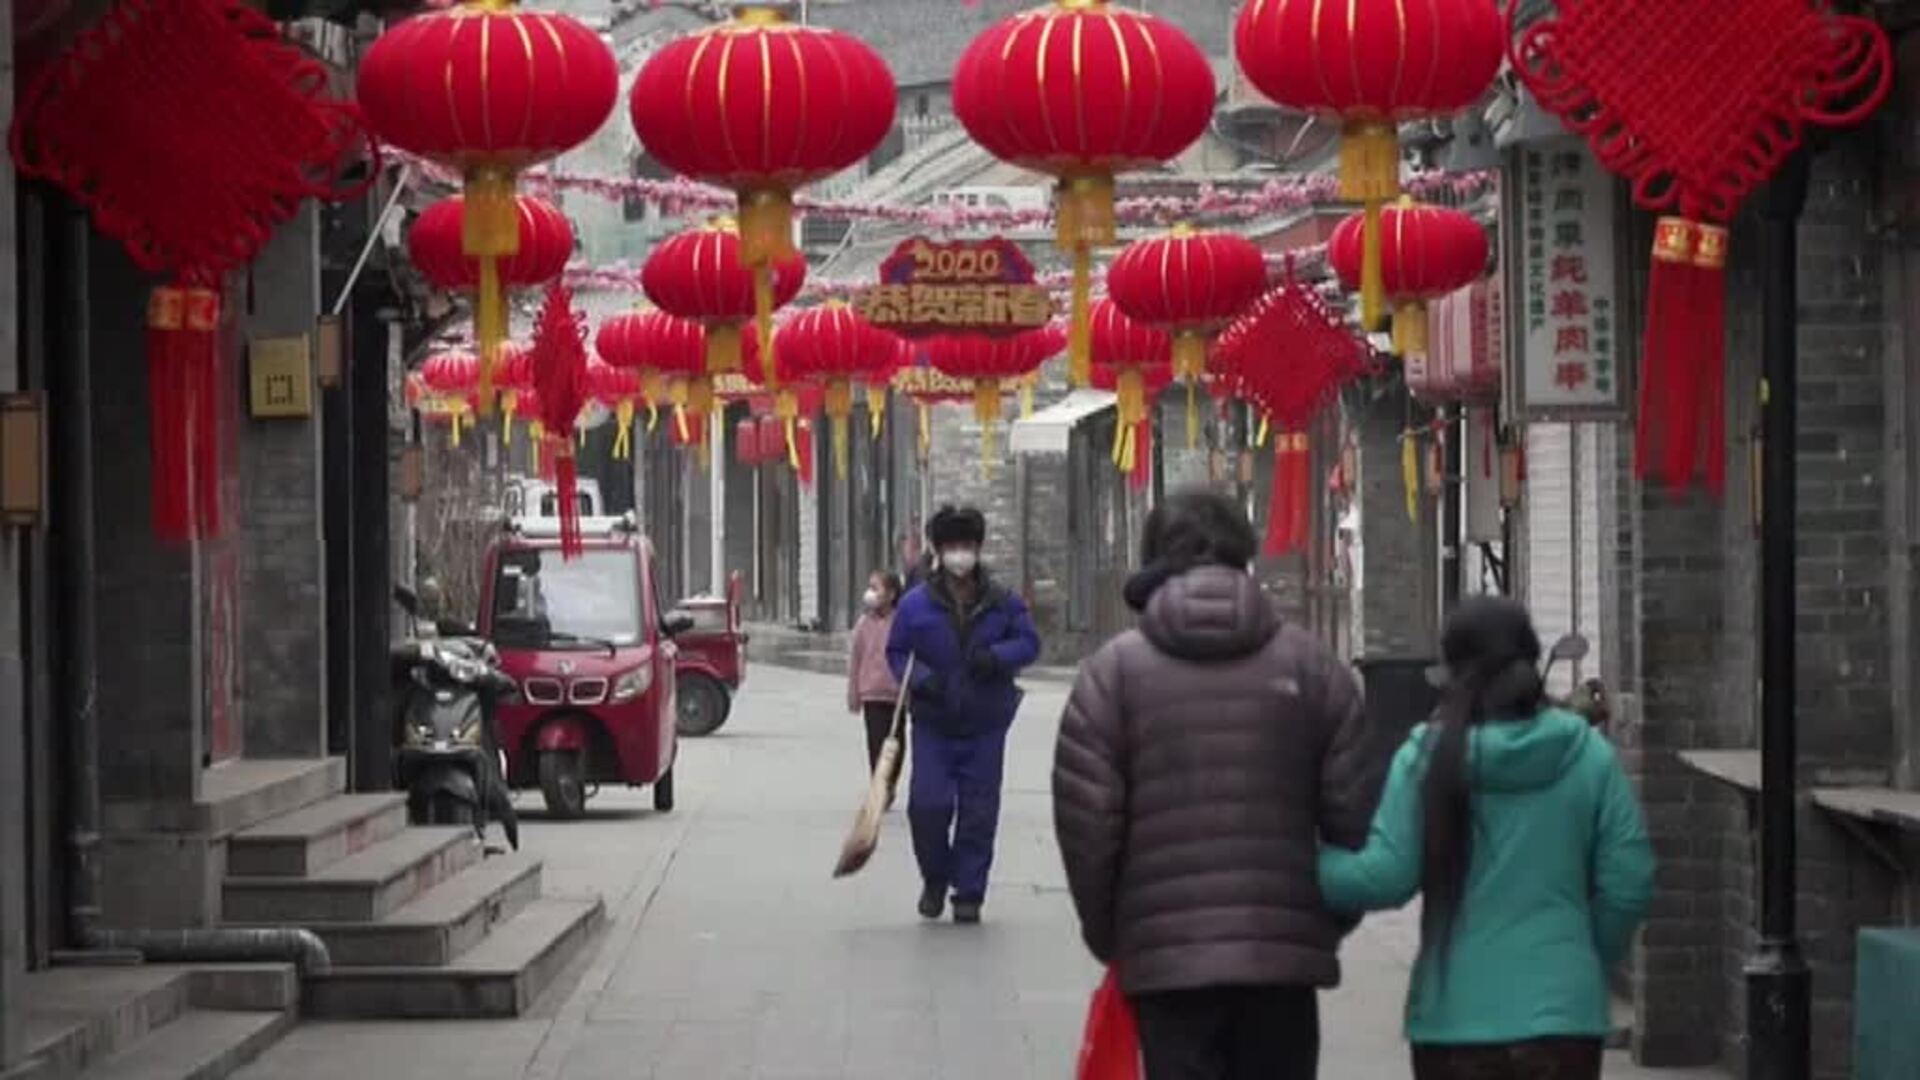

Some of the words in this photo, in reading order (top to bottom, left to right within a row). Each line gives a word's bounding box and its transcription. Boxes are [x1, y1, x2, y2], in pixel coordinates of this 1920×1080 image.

[914, 242, 999, 279] 2020
[862, 284, 1052, 326] 恭贺新春
